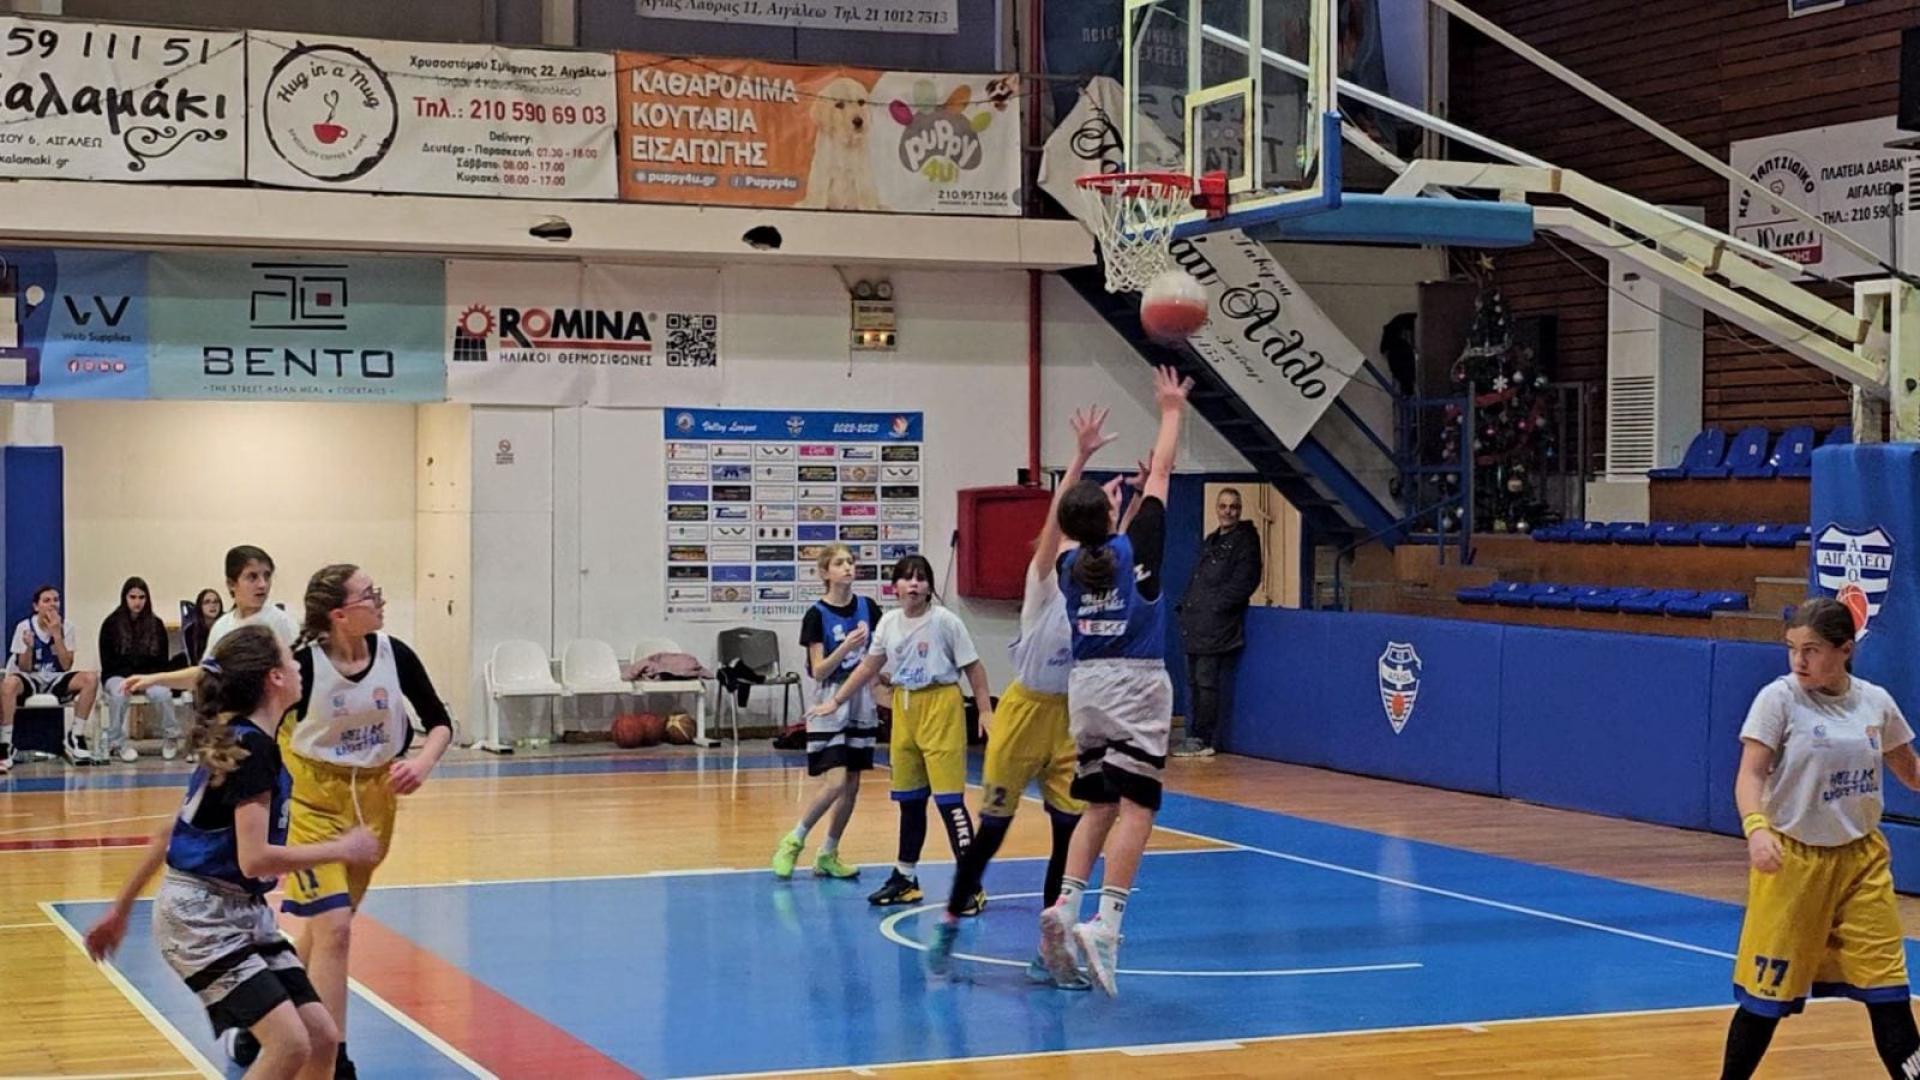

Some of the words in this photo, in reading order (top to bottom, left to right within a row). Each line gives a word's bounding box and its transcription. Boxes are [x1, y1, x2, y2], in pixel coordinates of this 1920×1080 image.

[7, 28, 59, 58] 59
[83, 32, 141, 60] 111
[163, 38, 210, 66] 51
[277, 72, 309, 103] Hug
[310, 61, 328, 77] in
[332, 66, 345, 78] a
[632, 68, 800, 104] ΚΑΘΑΡΟΑΙΜΑ
[0, 72, 227, 135] αλαμάκι
[470, 100, 506, 120] 210
[512, 102, 546, 123] 590
[552, 105, 576, 124] 69
[582, 106, 607, 125] 03
[632, 101, 758, 134] ΚΟΥΤΑΒΙΑ
[631, 134, 768, 168] ΕΙΣΑΓΩΓΗΣ
[1821, 162, 1865, 181] ΠΛΑΤΕΙΑ
[1867, 156, 1905, 175] ΔΑΒΑΚ
[1852, 207, 1871, 221] 210
[499, 308, 652, 348] ROMINA
[203, 346, 394, 378] BENTO
[500, 353, 550, 365] ΗΛΙΑΚΟΙ
[558, 353, 652, 366] ΘΕΡΜΟΣΙΦΩΝΕΣ
[1823, 551, 1886, 568] ΑΙΓΑΛΕΩ
[991, 786, 1007, 807] 2
[951, 807, 971, 849] NIKE
[1754, 954, 1791, 988] 77
